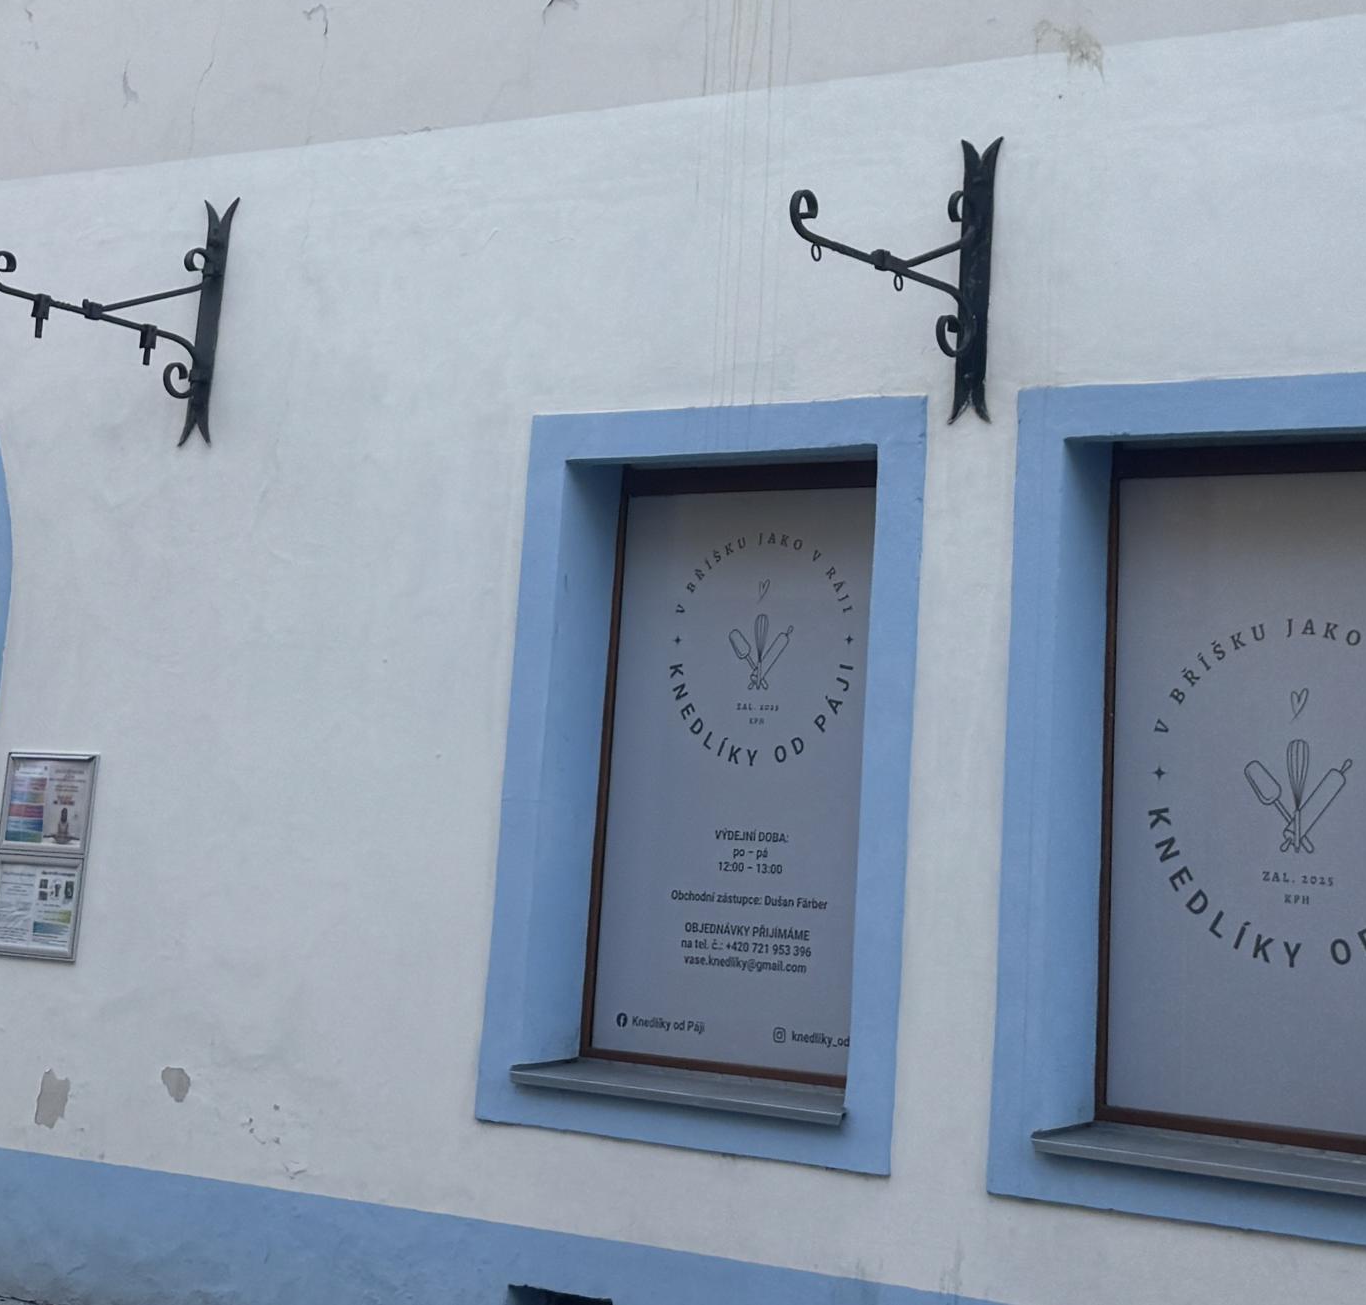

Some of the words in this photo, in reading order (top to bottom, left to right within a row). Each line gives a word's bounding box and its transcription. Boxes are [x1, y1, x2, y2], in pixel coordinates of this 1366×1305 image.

[675, 603, 686, 614] V
[757, 532, 803, 551] JAKO
[811, 549, 822, 562] V
[825, 566, 853, 613] RÁJI
[1154, 718, 1170, 735] V
[1169, 623, 1266, 705] BŘÍŠKU
[1286, 618, 1361, 647] JAKO
[669, 663, 758, 767] KNEDLÍKY
[774, 737, 805, 764] OD
[813, 664, 854, 733] PÁJI
[714, 828, 757, 843] VÝDEJNÍ
[758, 830, 790, 844] DOBA:
[732, 848, 746, 859] po
[756, 847, 769, 860] pá
[717, 861, 745, 873] 12:00
[755, 863, 783, 875] 13:00
[1148, 807, 1302, 968] KNEDLÍKY
[1261, 870, 1295, 884] ZAL.
[1301, 874, 1334, 887] 2025
[671, 889, 716, 904] Obchodní
[716, 891, 763, 909] zástupce:
[763, 893, 795, 908] Dušan
[1283, 893, 1311, 906] KPH
[684, 921, 750, 937] OBJEDNÁVKY
[752, 924, 811, 942] PŘIJÍMÁME
[681, 938, 693, 949] na
[694, 939, 709, 950] tel.
[725, 941, 750, 954] +420
[751, 942, 770, 955] 721
[772, 944, 792, 957] 953
[793, 945, 813, 958] 396
[683, 953, 808, 975] vase.knedliky@gmail.com
[631, 1015, 672, 1032] Knedlíky
[673, 1018, 686, 1032] od
